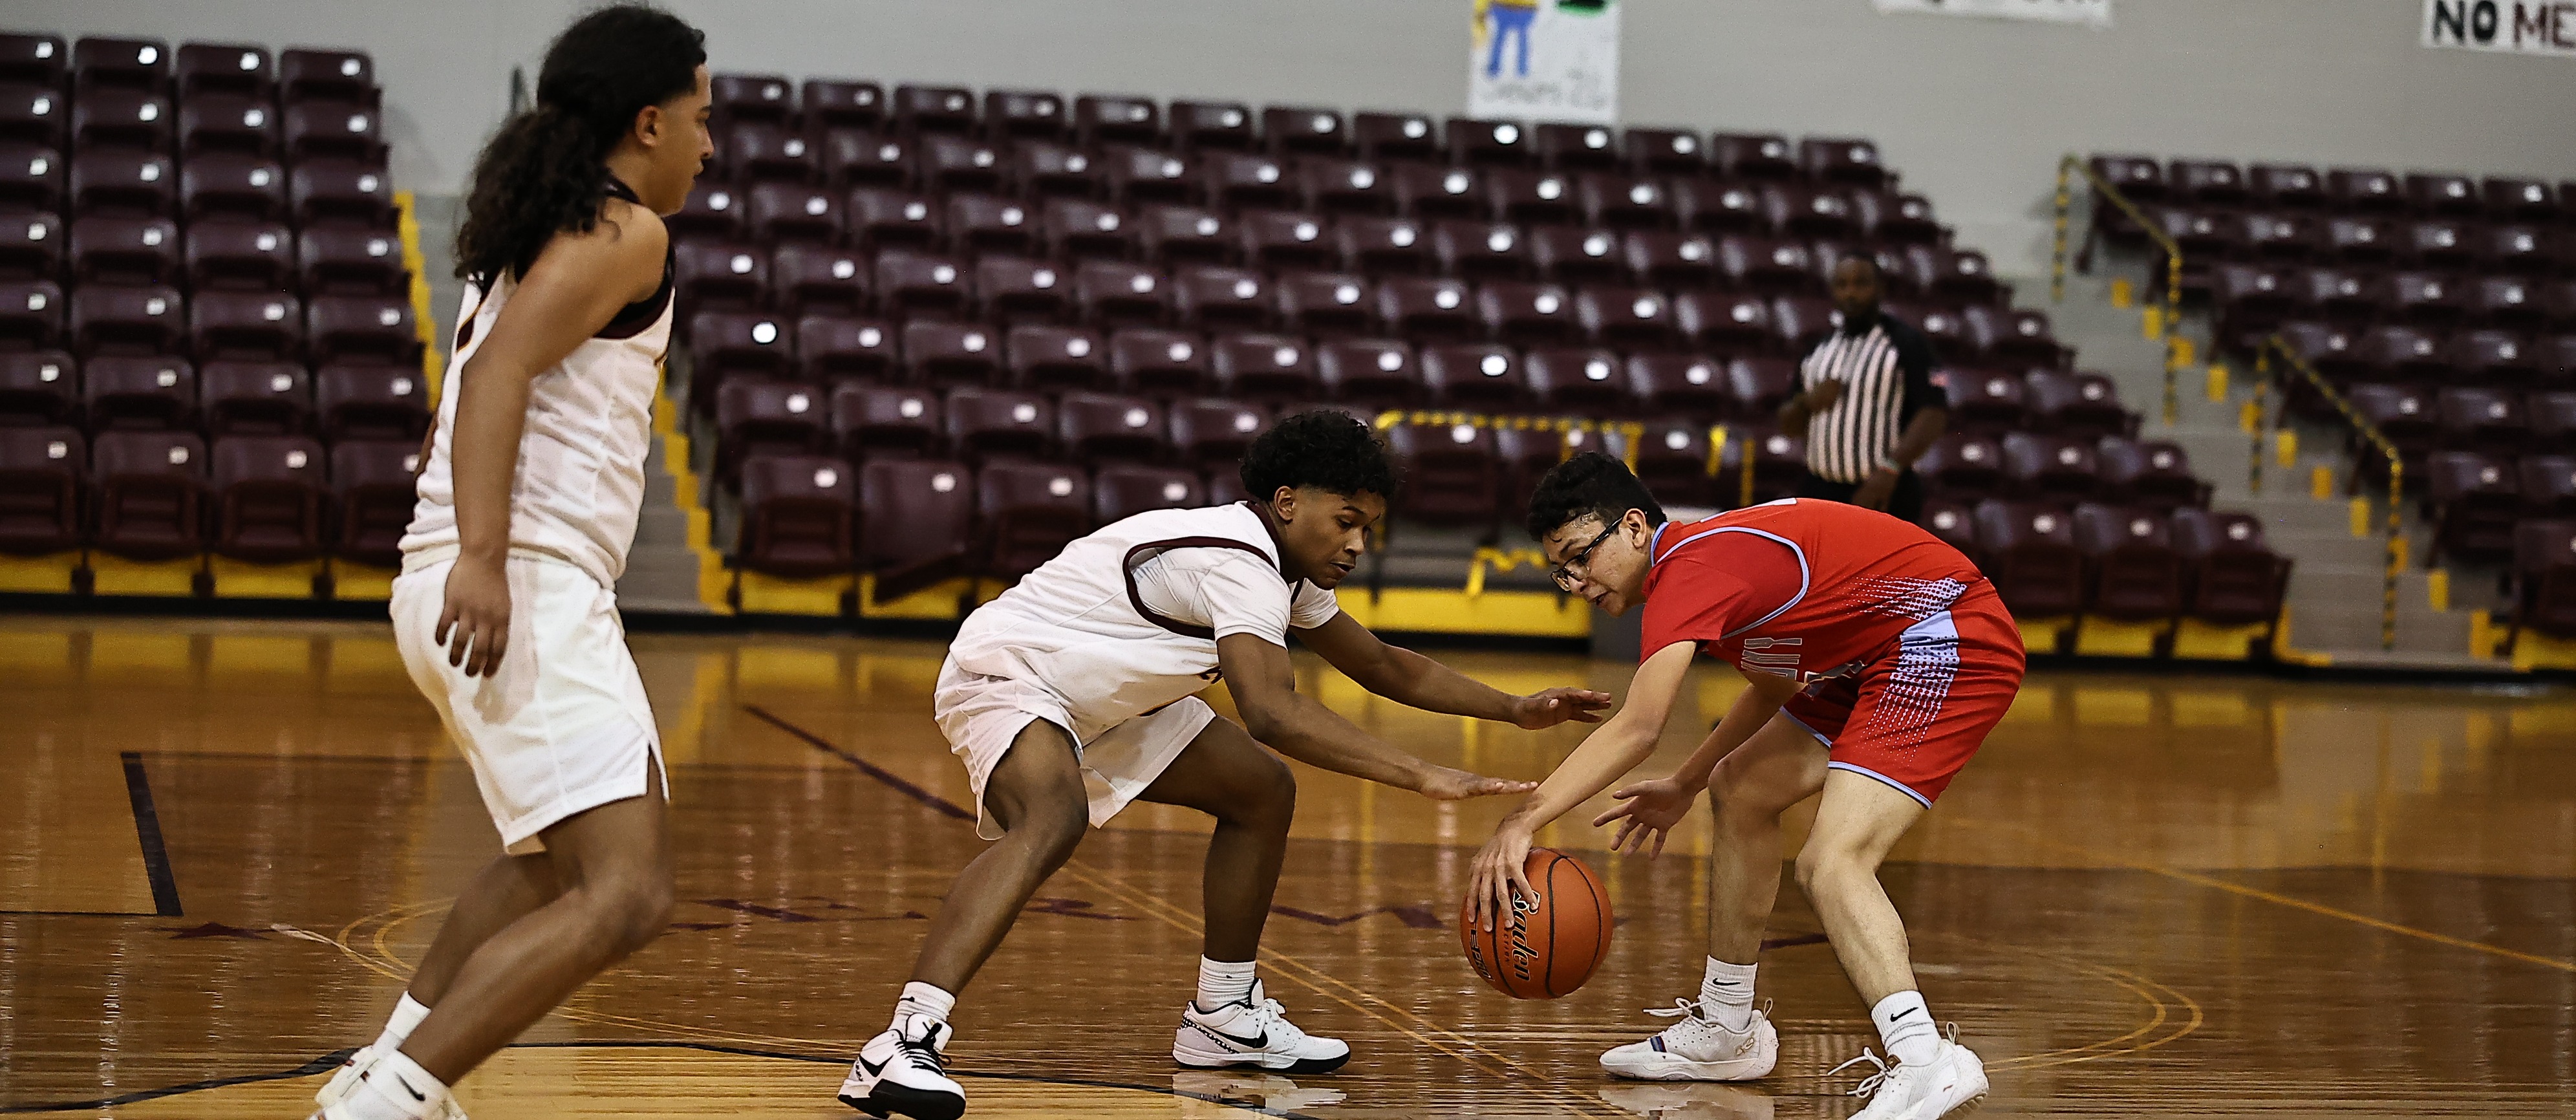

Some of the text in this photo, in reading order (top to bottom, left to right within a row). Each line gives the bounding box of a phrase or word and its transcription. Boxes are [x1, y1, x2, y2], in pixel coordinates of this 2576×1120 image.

[2433, 0, 2576, 48] NO ME
[1512, 888, 1541, 982] Baden
